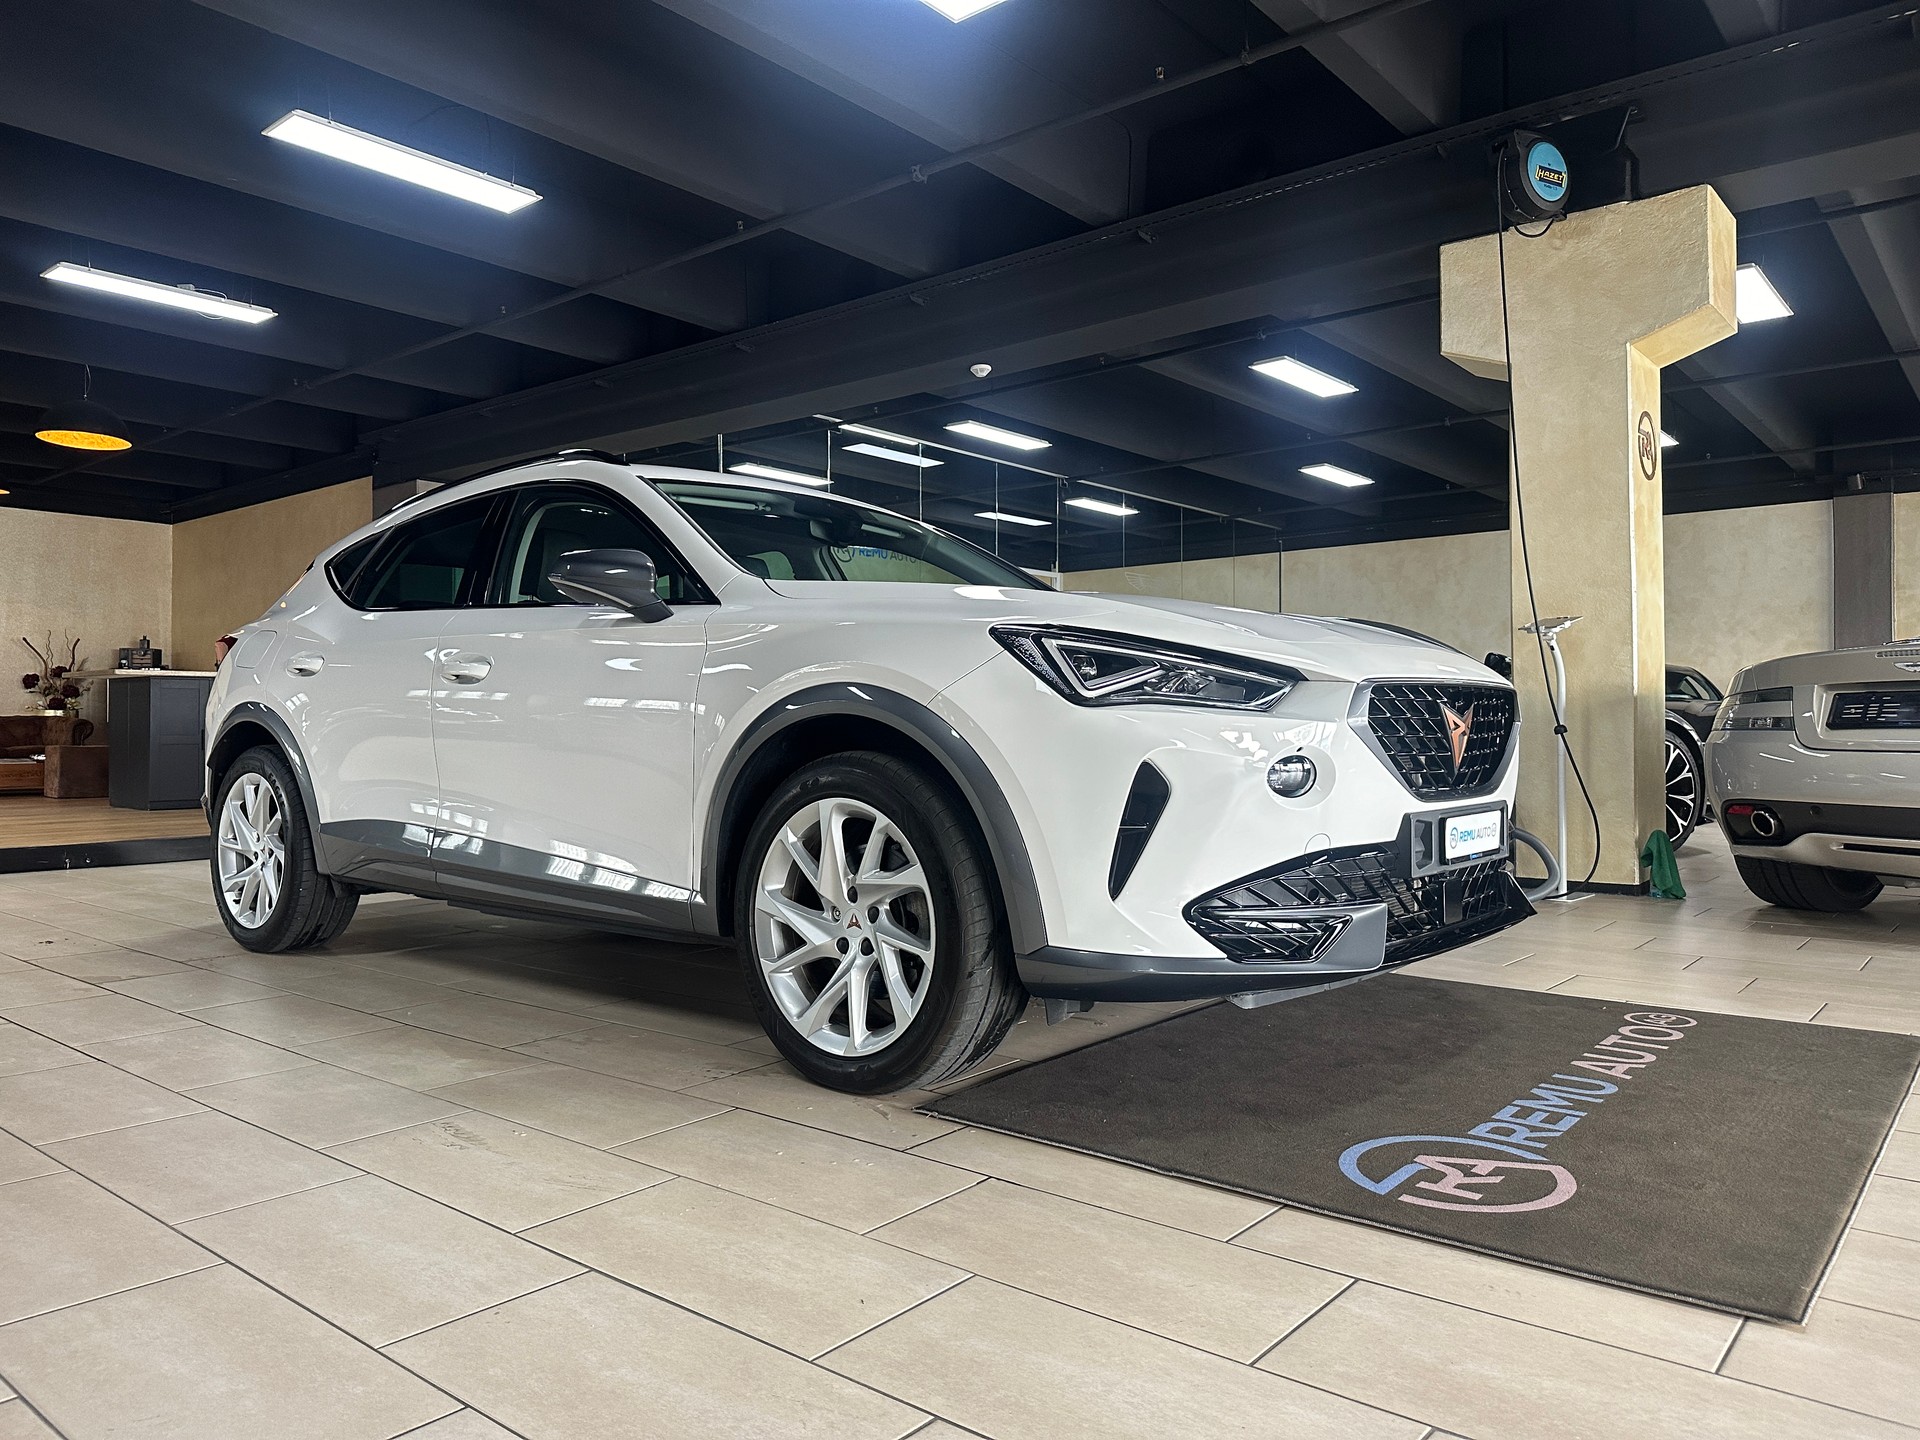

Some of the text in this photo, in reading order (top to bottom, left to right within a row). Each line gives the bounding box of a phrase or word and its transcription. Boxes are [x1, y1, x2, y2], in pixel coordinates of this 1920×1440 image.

[1538, 169, 1563, 181] HAZET
[859, 548, 887, 559] REMU
[1459, 829, 1476, 843] REMU
[1476, 826, 1491, 838] AUTO
[1468, 1074, 1619, 1149] REMU
[1571, 1025, 1685, 1079] AUTO
